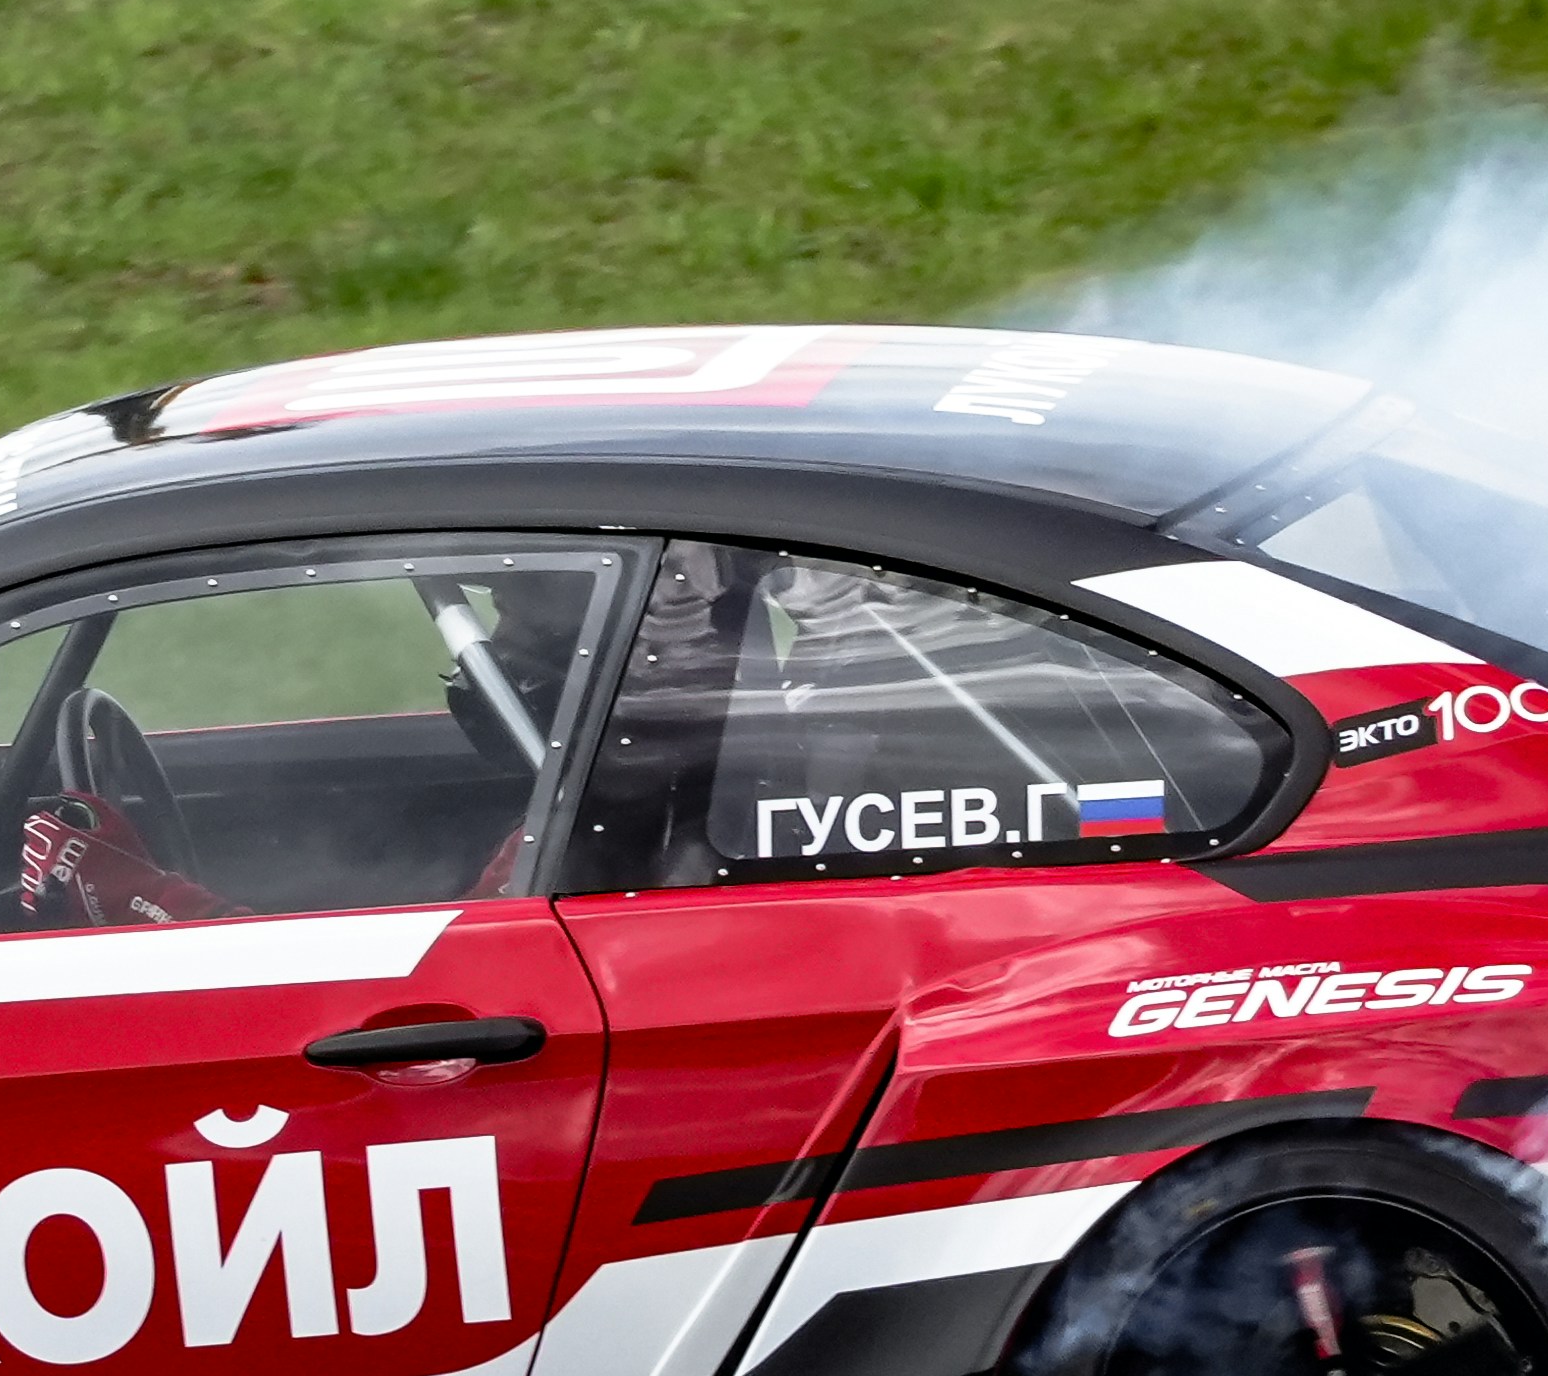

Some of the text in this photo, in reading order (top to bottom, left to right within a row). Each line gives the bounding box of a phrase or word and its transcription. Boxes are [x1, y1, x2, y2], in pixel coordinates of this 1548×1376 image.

[1339, 713, 1421, 753] ЭКТО
[756, 781, 1068, 859] ГУСЕВ.Г
[1107, 963, 1533, 1038] GENESIS
[1125, 960, 1342, 993] МОТОРНЫЕ МАСЛА
